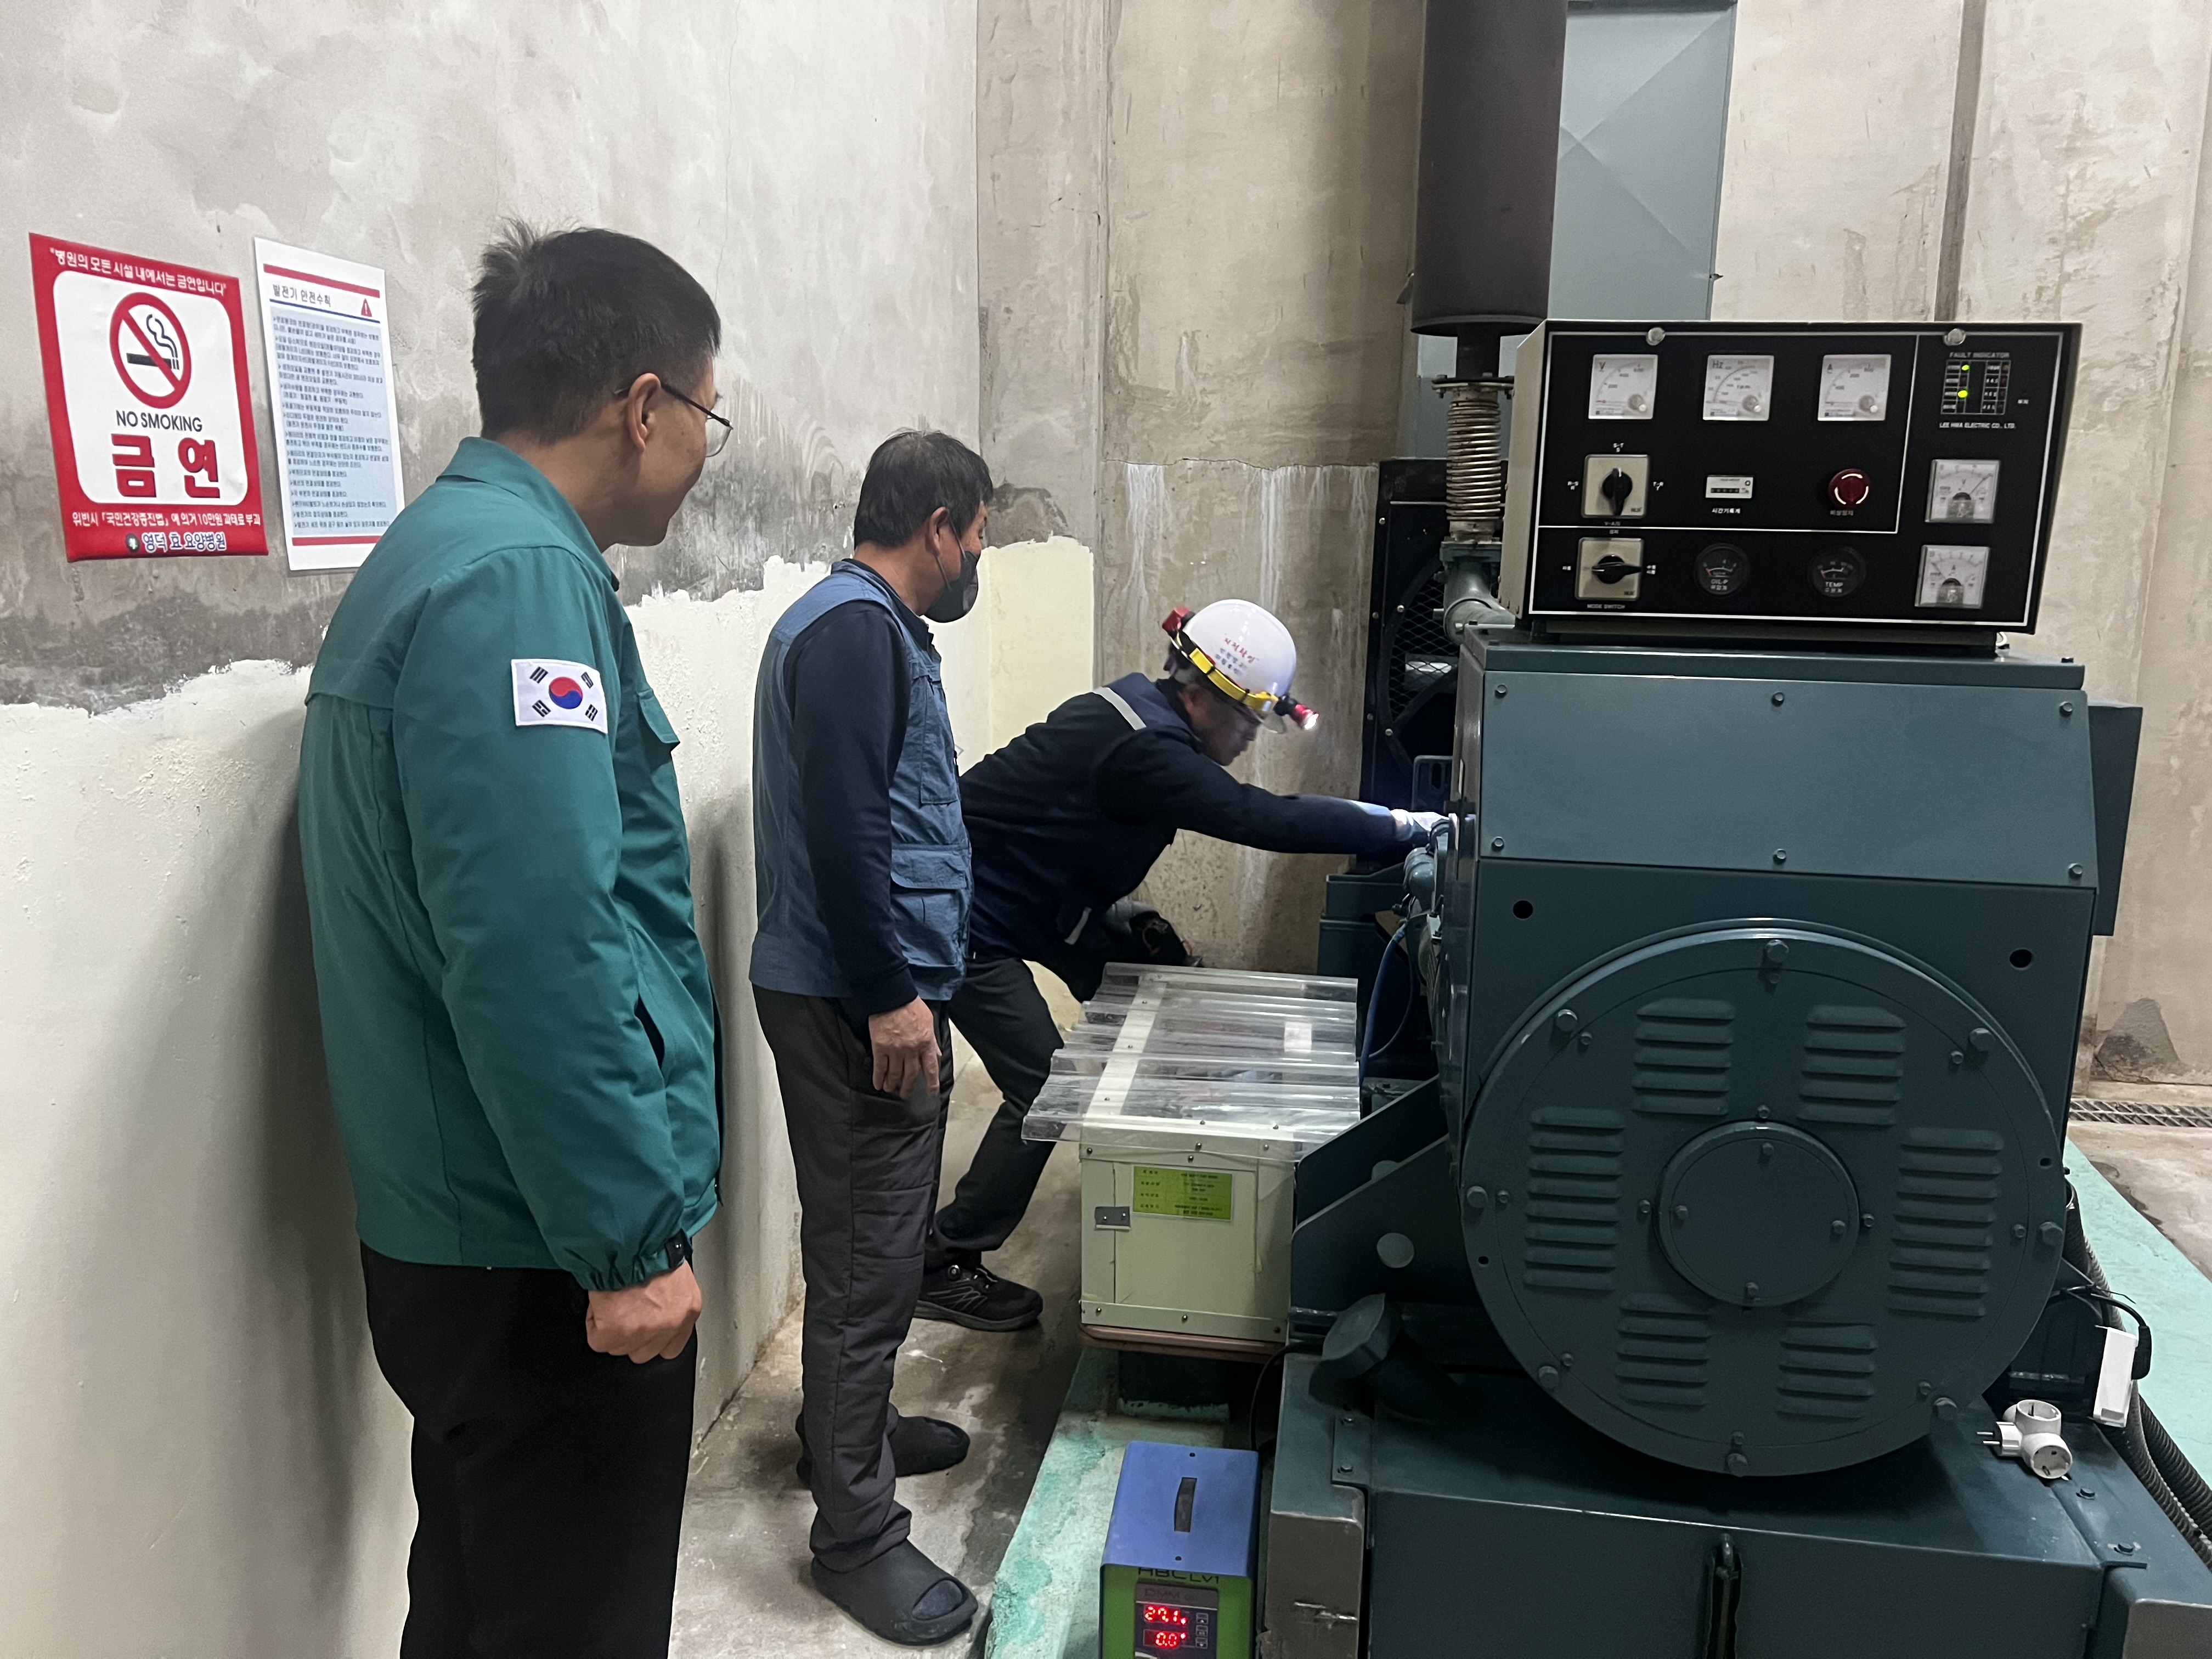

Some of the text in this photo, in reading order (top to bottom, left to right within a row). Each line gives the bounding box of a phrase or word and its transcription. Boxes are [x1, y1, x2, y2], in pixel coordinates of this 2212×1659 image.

[90, 257, 111, 274] 모든
[113, 262, 133, 279] 시설
[134, 266, 176, 286] 내에서는
[272, 284, 331, 307] 발전기 안전수칙
[116, 410, 202, 432] NO SMOKING
[72, 512, 99, 527] 위반시
[180, 512, 198, 526] 의거
[198, 513, 223, 526] 10만원
[223, 514, 245, 526] 과태료
[246, 514, 261, 526] 부과
[142, 532, 226, 553] 영덕 효 요양병원
[1155, 1632, 1177, 1647] 0.0
